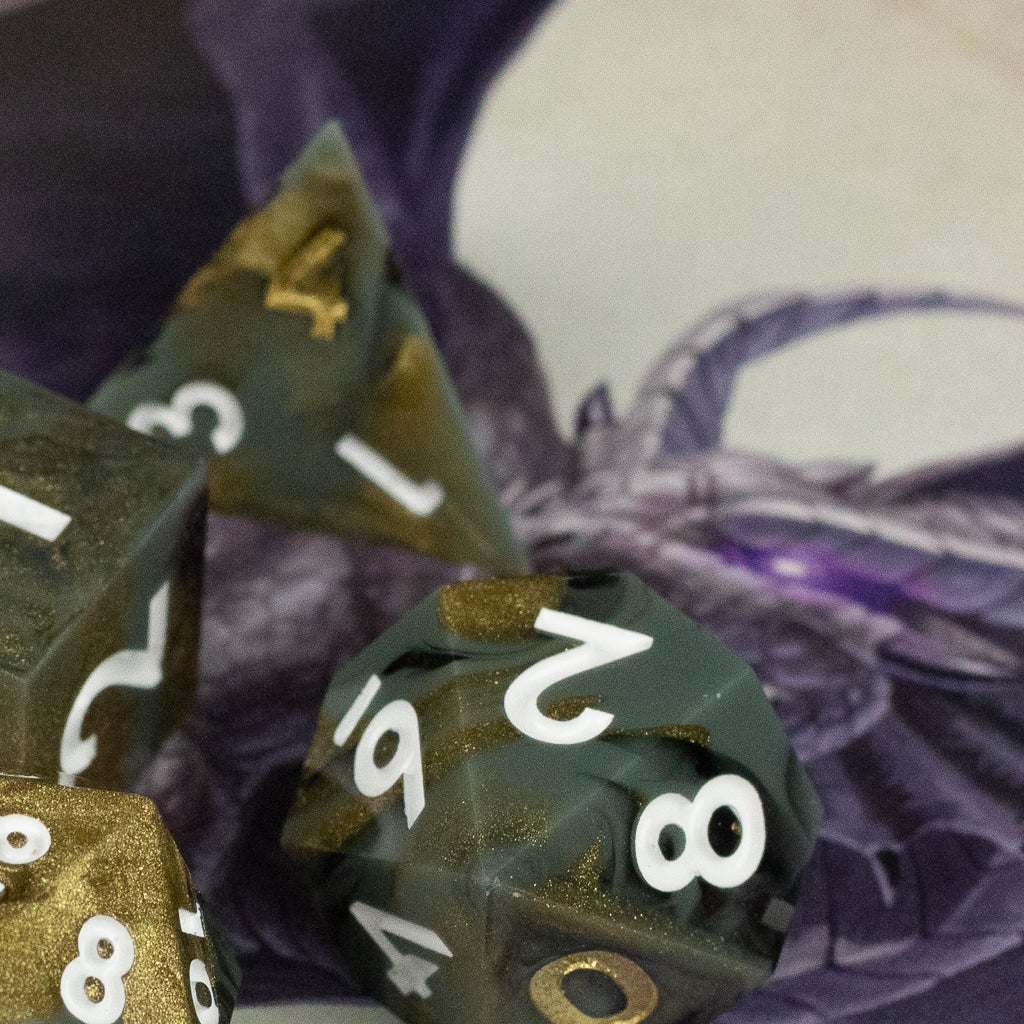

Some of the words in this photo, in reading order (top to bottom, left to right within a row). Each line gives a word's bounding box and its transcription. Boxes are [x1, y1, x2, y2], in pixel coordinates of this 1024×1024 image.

[265, 226, 349, 340] 4
[333, 432, 446, 517] 1
[503, 607, 653, 744] 2
[635, 773, 766, 892] 8
[348, 900, 454, 998] 4
